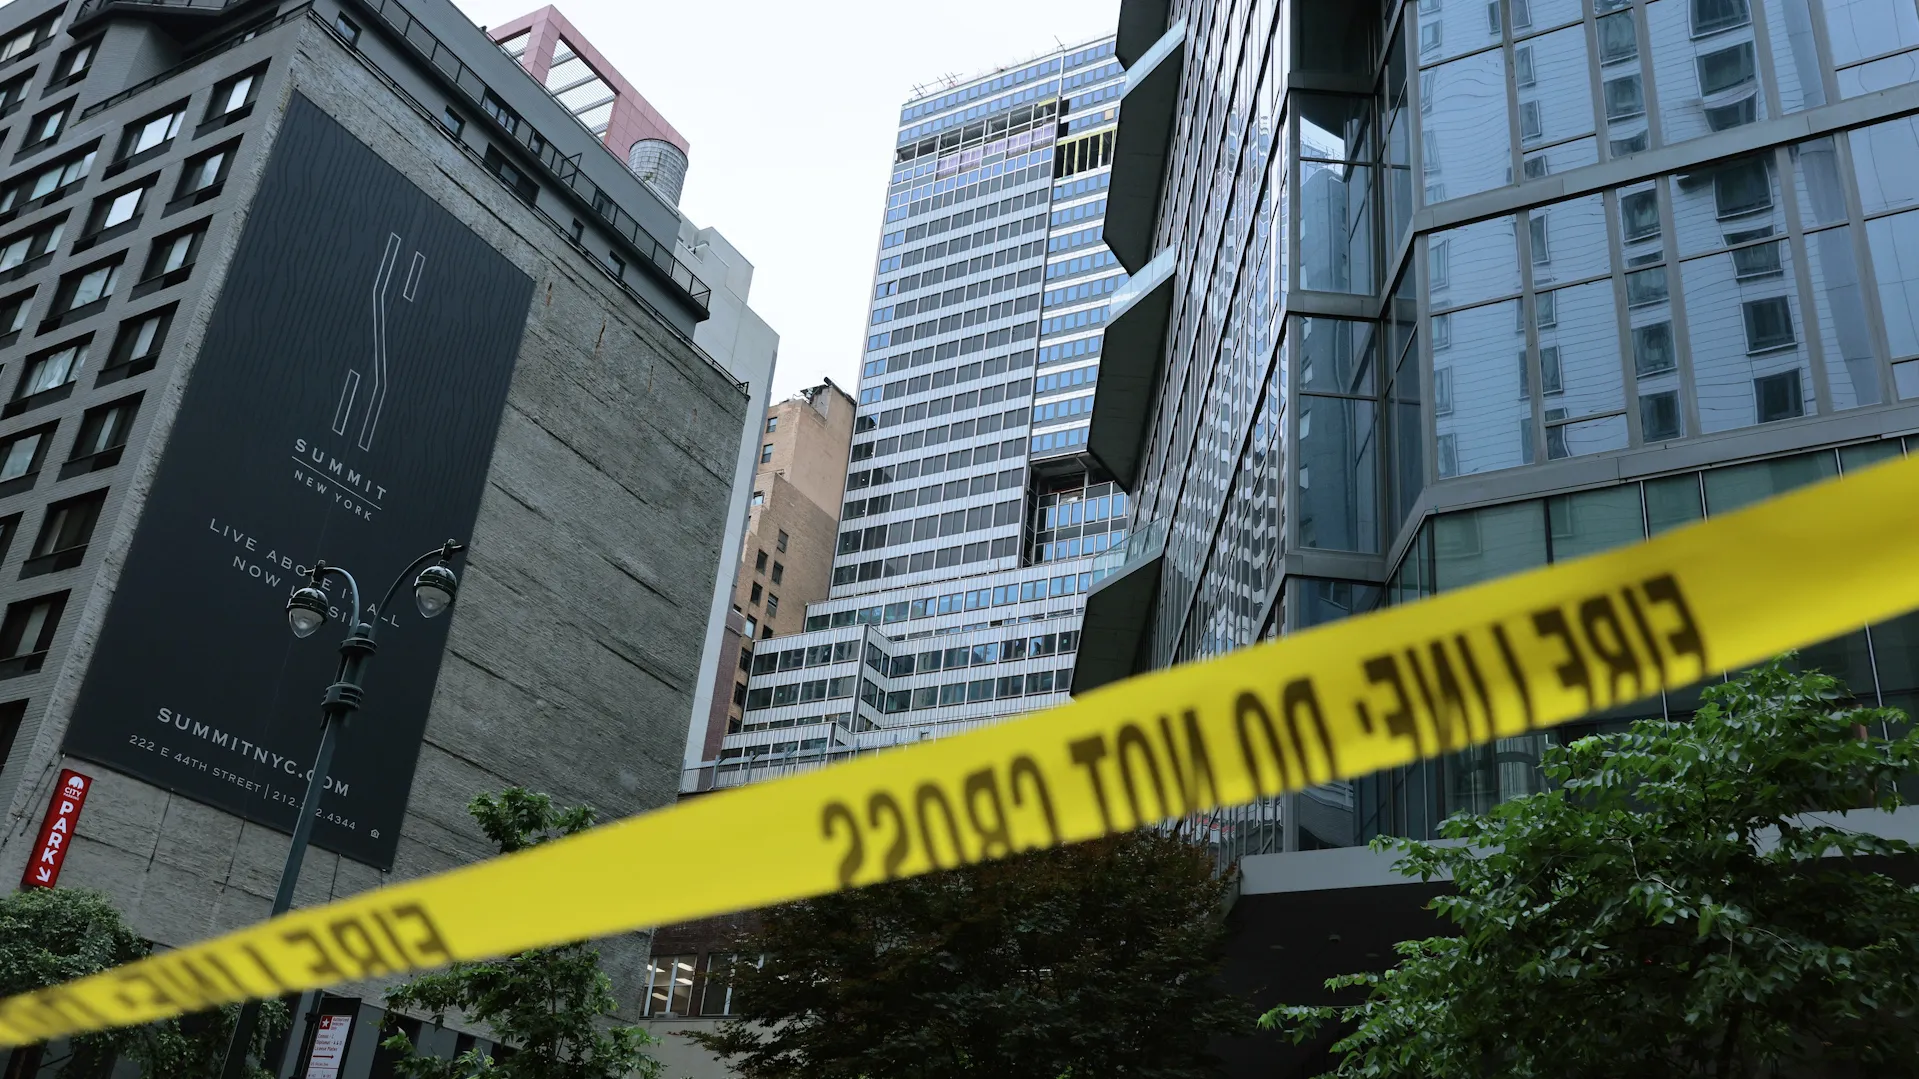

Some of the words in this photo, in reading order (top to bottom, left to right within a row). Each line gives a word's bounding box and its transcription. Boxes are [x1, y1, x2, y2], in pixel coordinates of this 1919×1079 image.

[294, 470, 327, 495] NEW
[334, 492, 372, 522] YORK
[295, 438, 387, 500] SUMMIT
[209, 518, 258, 552] LIVE
[266, 550, 333, 592] ABOE
[366, 603, 400, 628] AL
[232, 556, 281, 588] NOW
[64, 787, 82, 798] CITY
[129, 734, 156, 752] 222
[160, 747, 170, 758] E
[173, 753, 208, 772] 44TH
[212, 767, 262, 793] STREET
[41, 800, 75, 865] PARK
